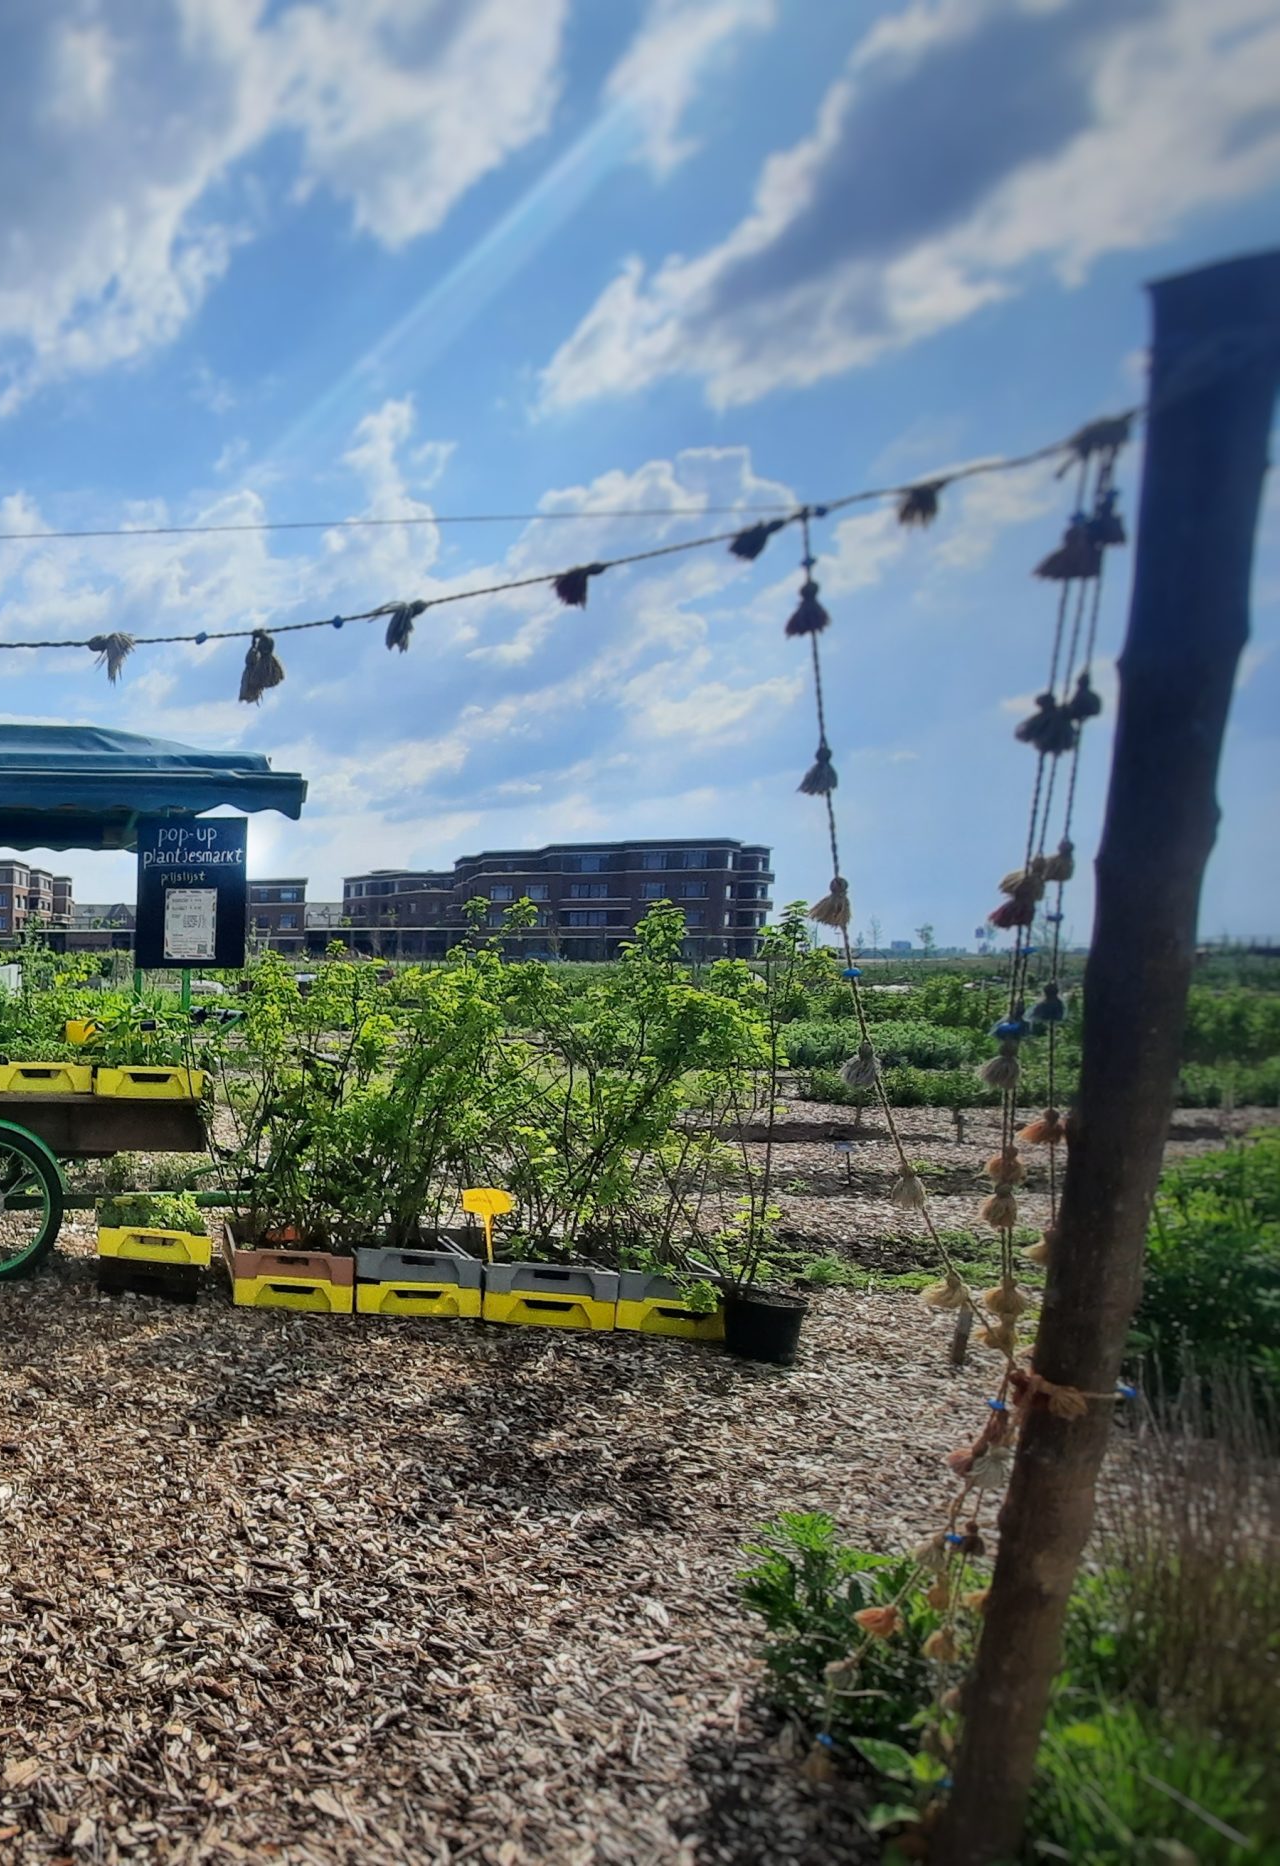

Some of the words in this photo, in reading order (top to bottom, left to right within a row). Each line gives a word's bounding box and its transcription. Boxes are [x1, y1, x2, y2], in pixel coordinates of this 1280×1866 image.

[158, 828, 218, 849] pop-up
[143, 848, 243, 869] plantjesmarkt
[161, 871, 206, 886] prijslijst
